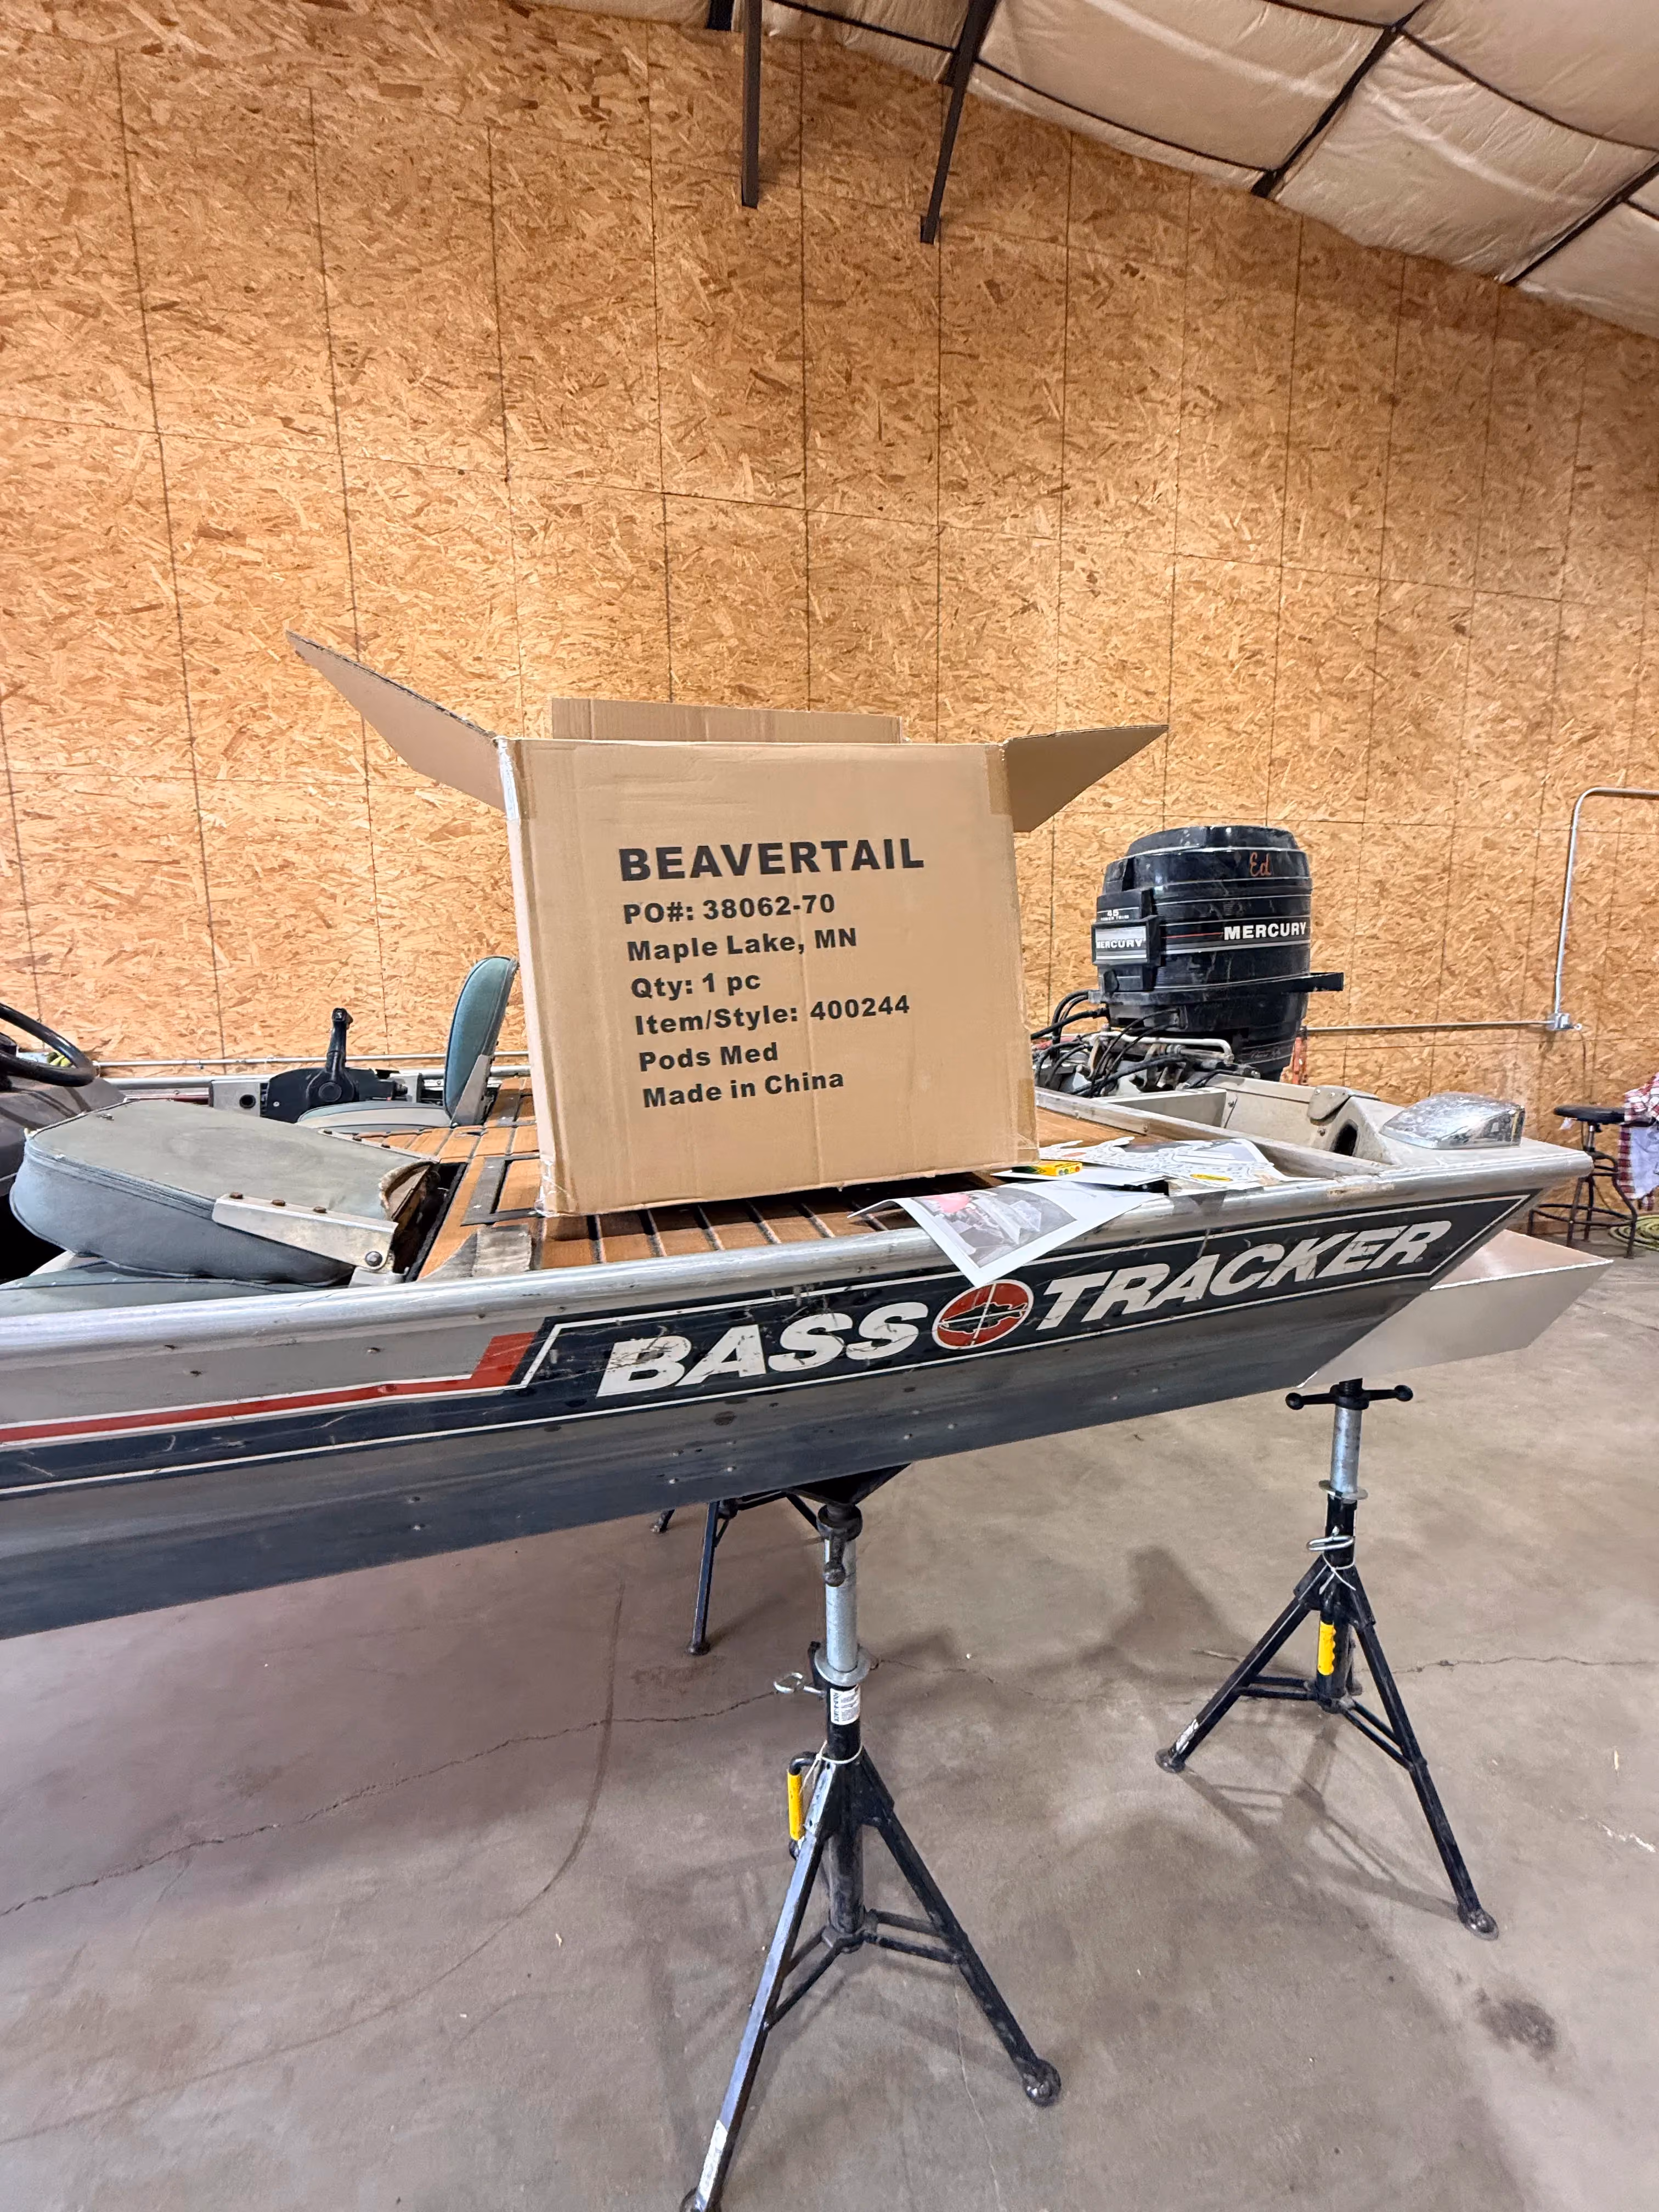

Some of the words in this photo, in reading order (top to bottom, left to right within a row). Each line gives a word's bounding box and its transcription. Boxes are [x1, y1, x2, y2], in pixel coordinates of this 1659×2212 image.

[619, 839, 924, 881] BEAVERTAIL
[1250, 851, 1272, 877] Ed
[624, 902, 693, 924] PO#:
[703, 894, 834, 919] 38062-70
[628, 938, 717, 963] Maple
[727, 933, 804, 954] Lake,
[815, 928, 856, 949] MN
[1224, 922, 1307, 940] MERCURY
[631, 978, 692, 1001] Qty:
[703, 973, 714, 992] 1
[727, 975, 760, 996] pc
[636, 1006, 797, 1035] Item/Style:
[811, 995, 909, 1020] 400244
[639, 1048, 710, 1071] Pods
[720, 1042, 777, 1065] Med
[643, 1084, 721, 1108] Made
[731, 1080, 755, 1098] in
[765, 1073, 843, 1094] China
[596, 1302, 928, 1397] BASS
[1036, 1221, 1452, 1330] TRACKER
